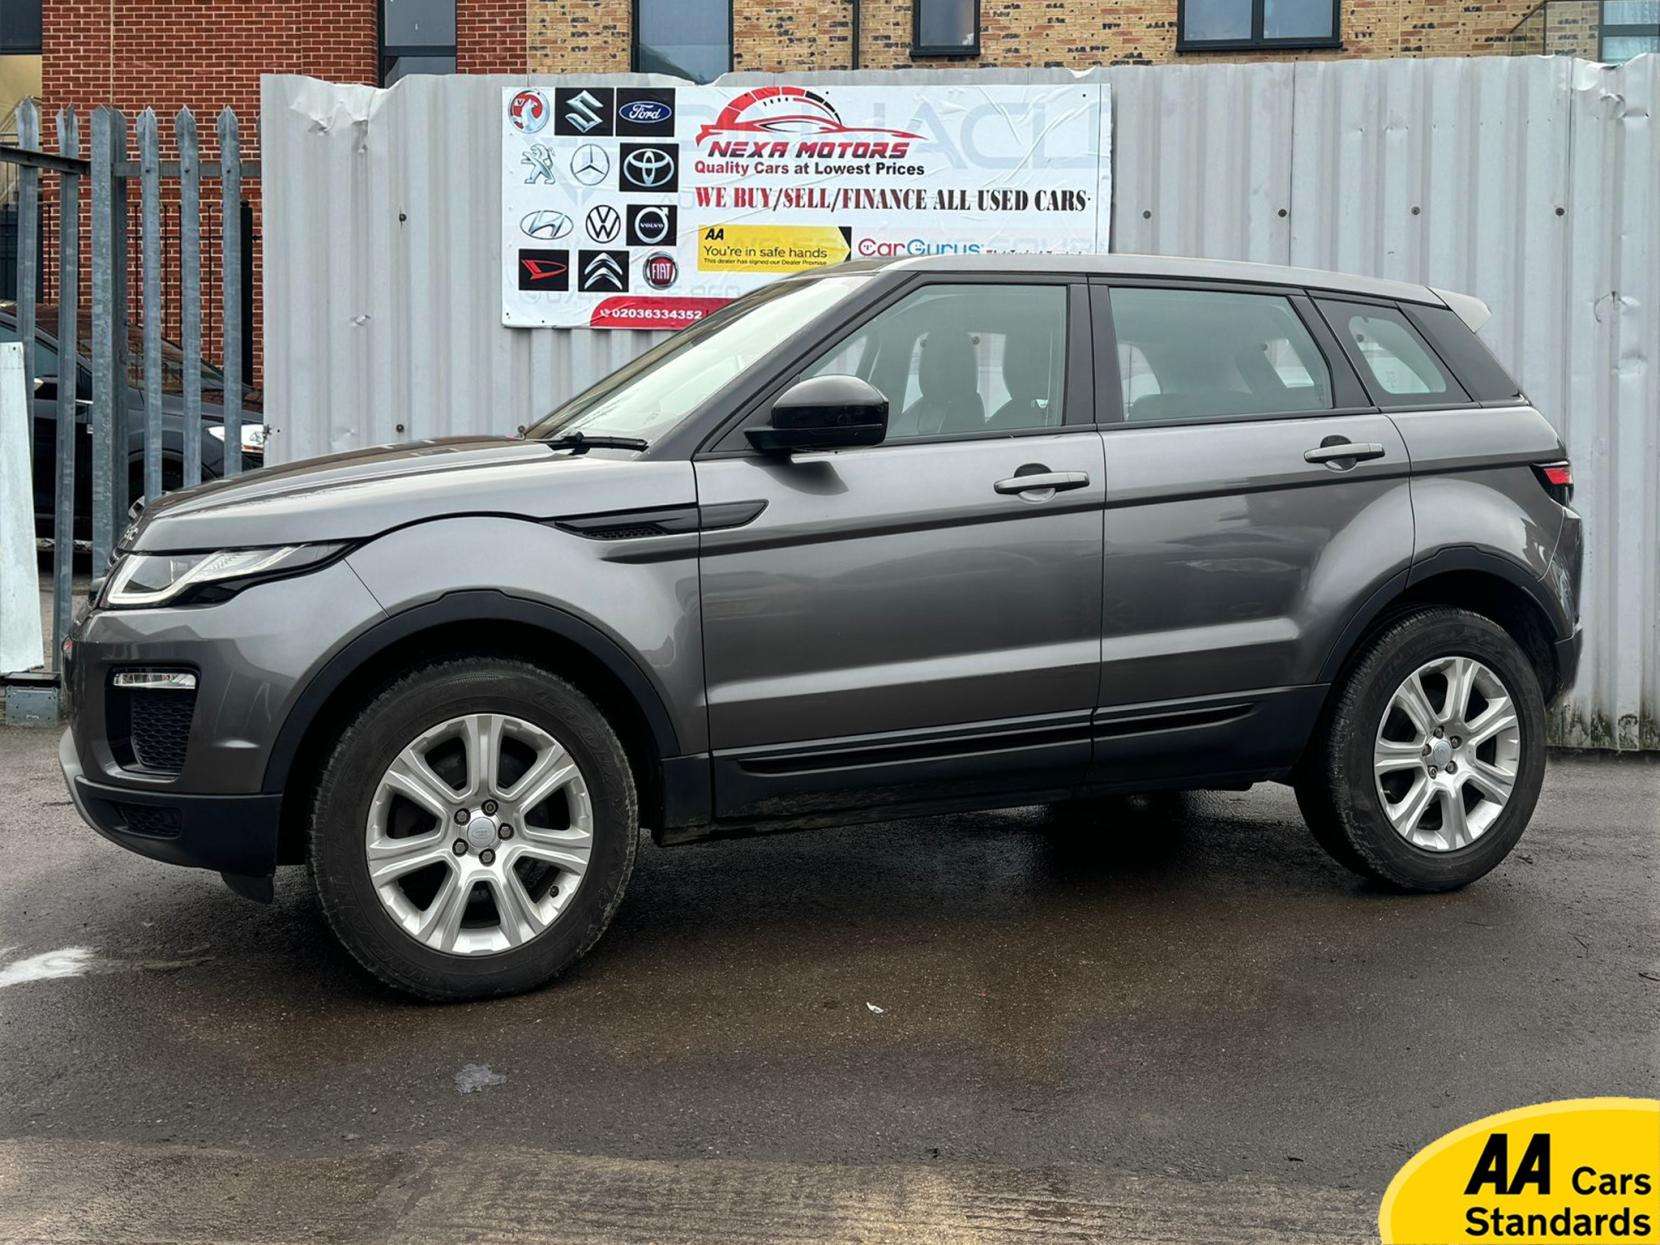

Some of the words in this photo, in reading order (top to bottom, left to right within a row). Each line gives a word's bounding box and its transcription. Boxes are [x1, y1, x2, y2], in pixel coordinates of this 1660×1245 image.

[629, 104, 661, 119] Ford
[708, 141, 790, 158] NEXA
[796, 141, 910, 159] MOTORS
[694, 160, 749, 176] Quality
[754, 161, 789, 174] Cars
[795, 162, 809, 174] at
[814, 162, 870, 175] Lowest
[876, 162, 924, 176] Prices
[695, 187, 727, 208] WE
[933, 189, 971, 210] ALL
[977, 189, 1028, 211] USED
[1034, 189, 1087, 211] CARS
[705, 228, 725, 241] AA
[704, 246, 742, 257] You're
[745, 246, 756, 257] in
[760, 246, 785, 258] safe
[786, 247, 828, 258] hands
[749, 258, 769, 266] signed
[651, 263, 671, 280] FIAT
[612, 308, 703, 319] 02036334352
